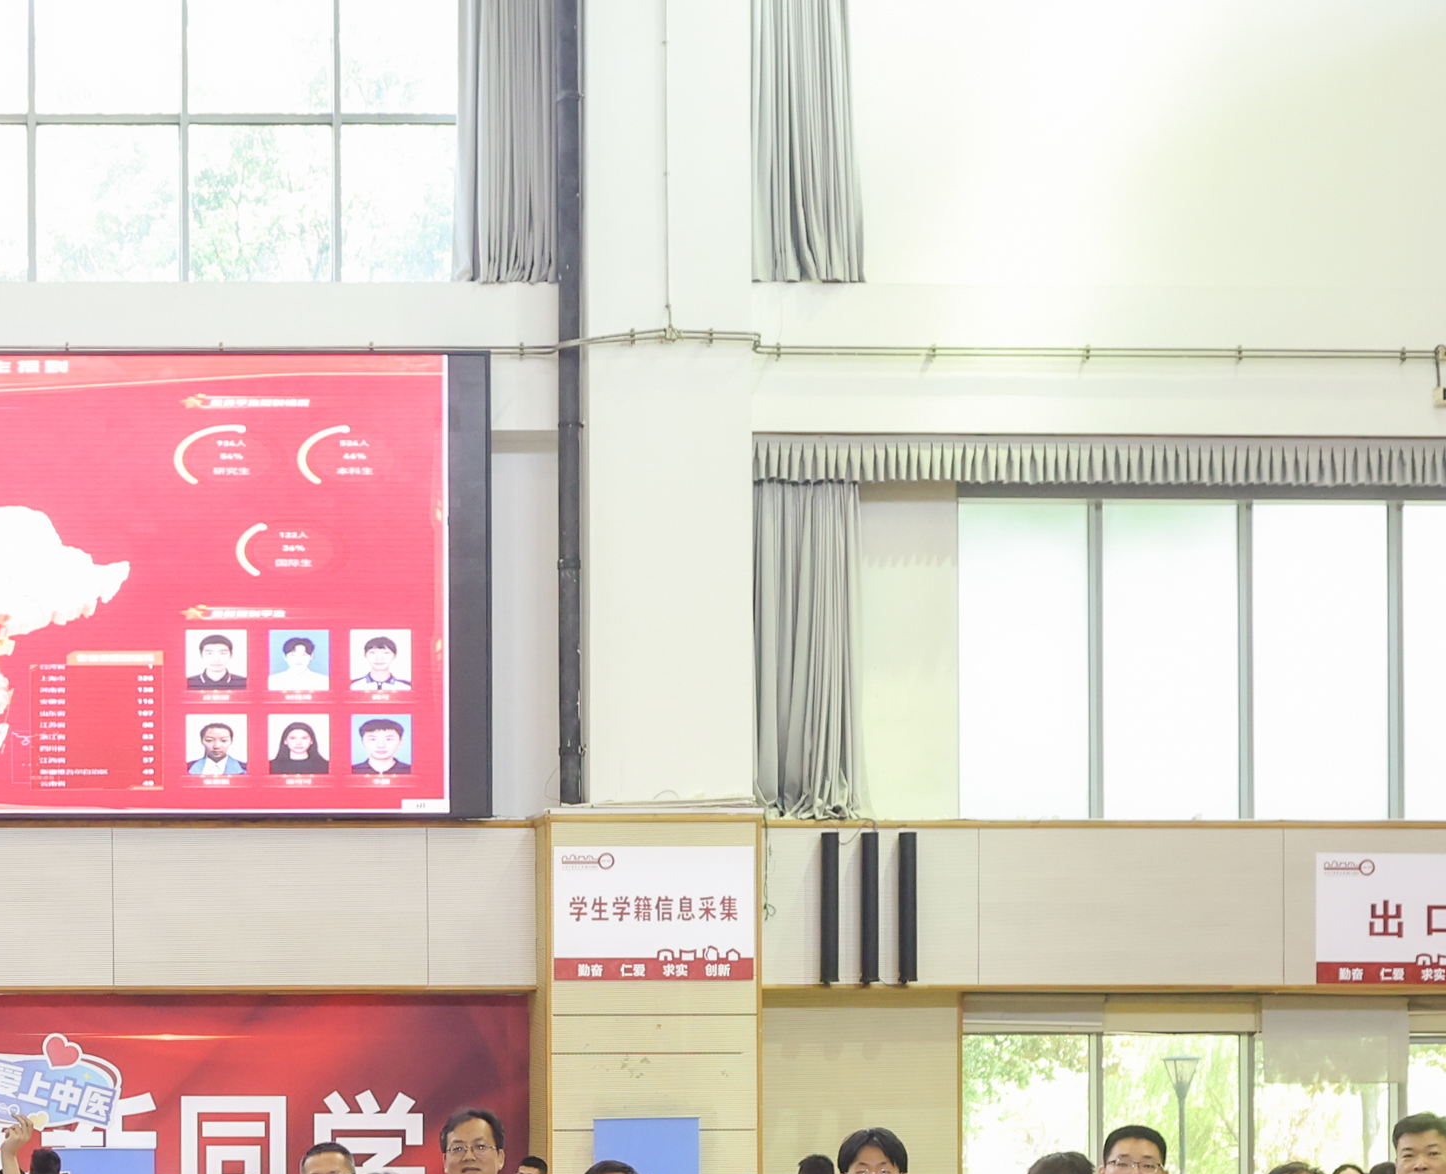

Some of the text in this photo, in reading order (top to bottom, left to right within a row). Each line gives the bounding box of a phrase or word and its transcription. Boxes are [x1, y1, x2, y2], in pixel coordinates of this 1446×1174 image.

[569, 895, 738, 922] 学生学籍信息采集
[577, 964, 731, 978] 勤奋 仁爱 求实 创新
[1339, 968, 1364, 982] 勤奋
[1380, 968, 1405, 982] 仁爱
[1421, 968, 1446, 982] 求实
